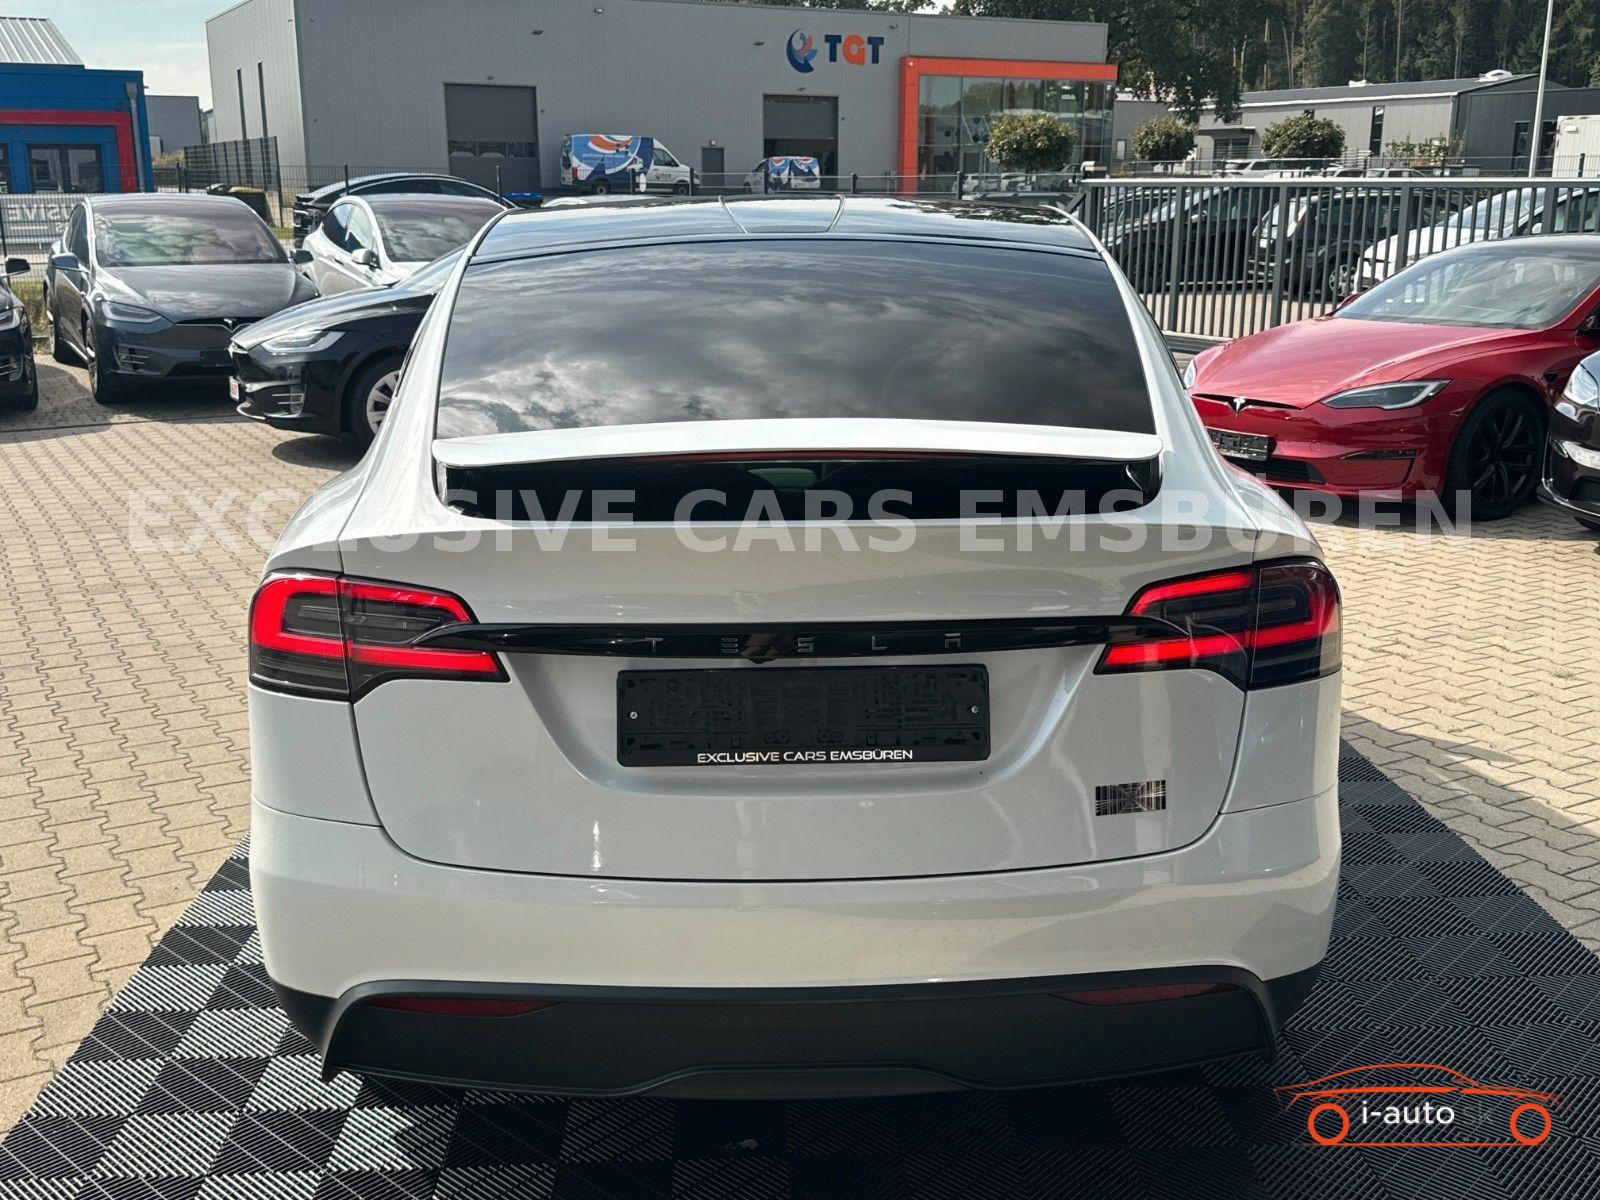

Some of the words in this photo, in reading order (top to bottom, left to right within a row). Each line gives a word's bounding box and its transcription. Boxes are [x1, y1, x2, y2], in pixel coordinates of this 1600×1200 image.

[824, 34, 885, 66] TGT
[645, 632, 962, 654] TESLA
[697, 752, 780, 764] EXCLUSIVE
[783, 751, 827, 762] CARS
[830, 748, 914, 761] EMSBÜREN
